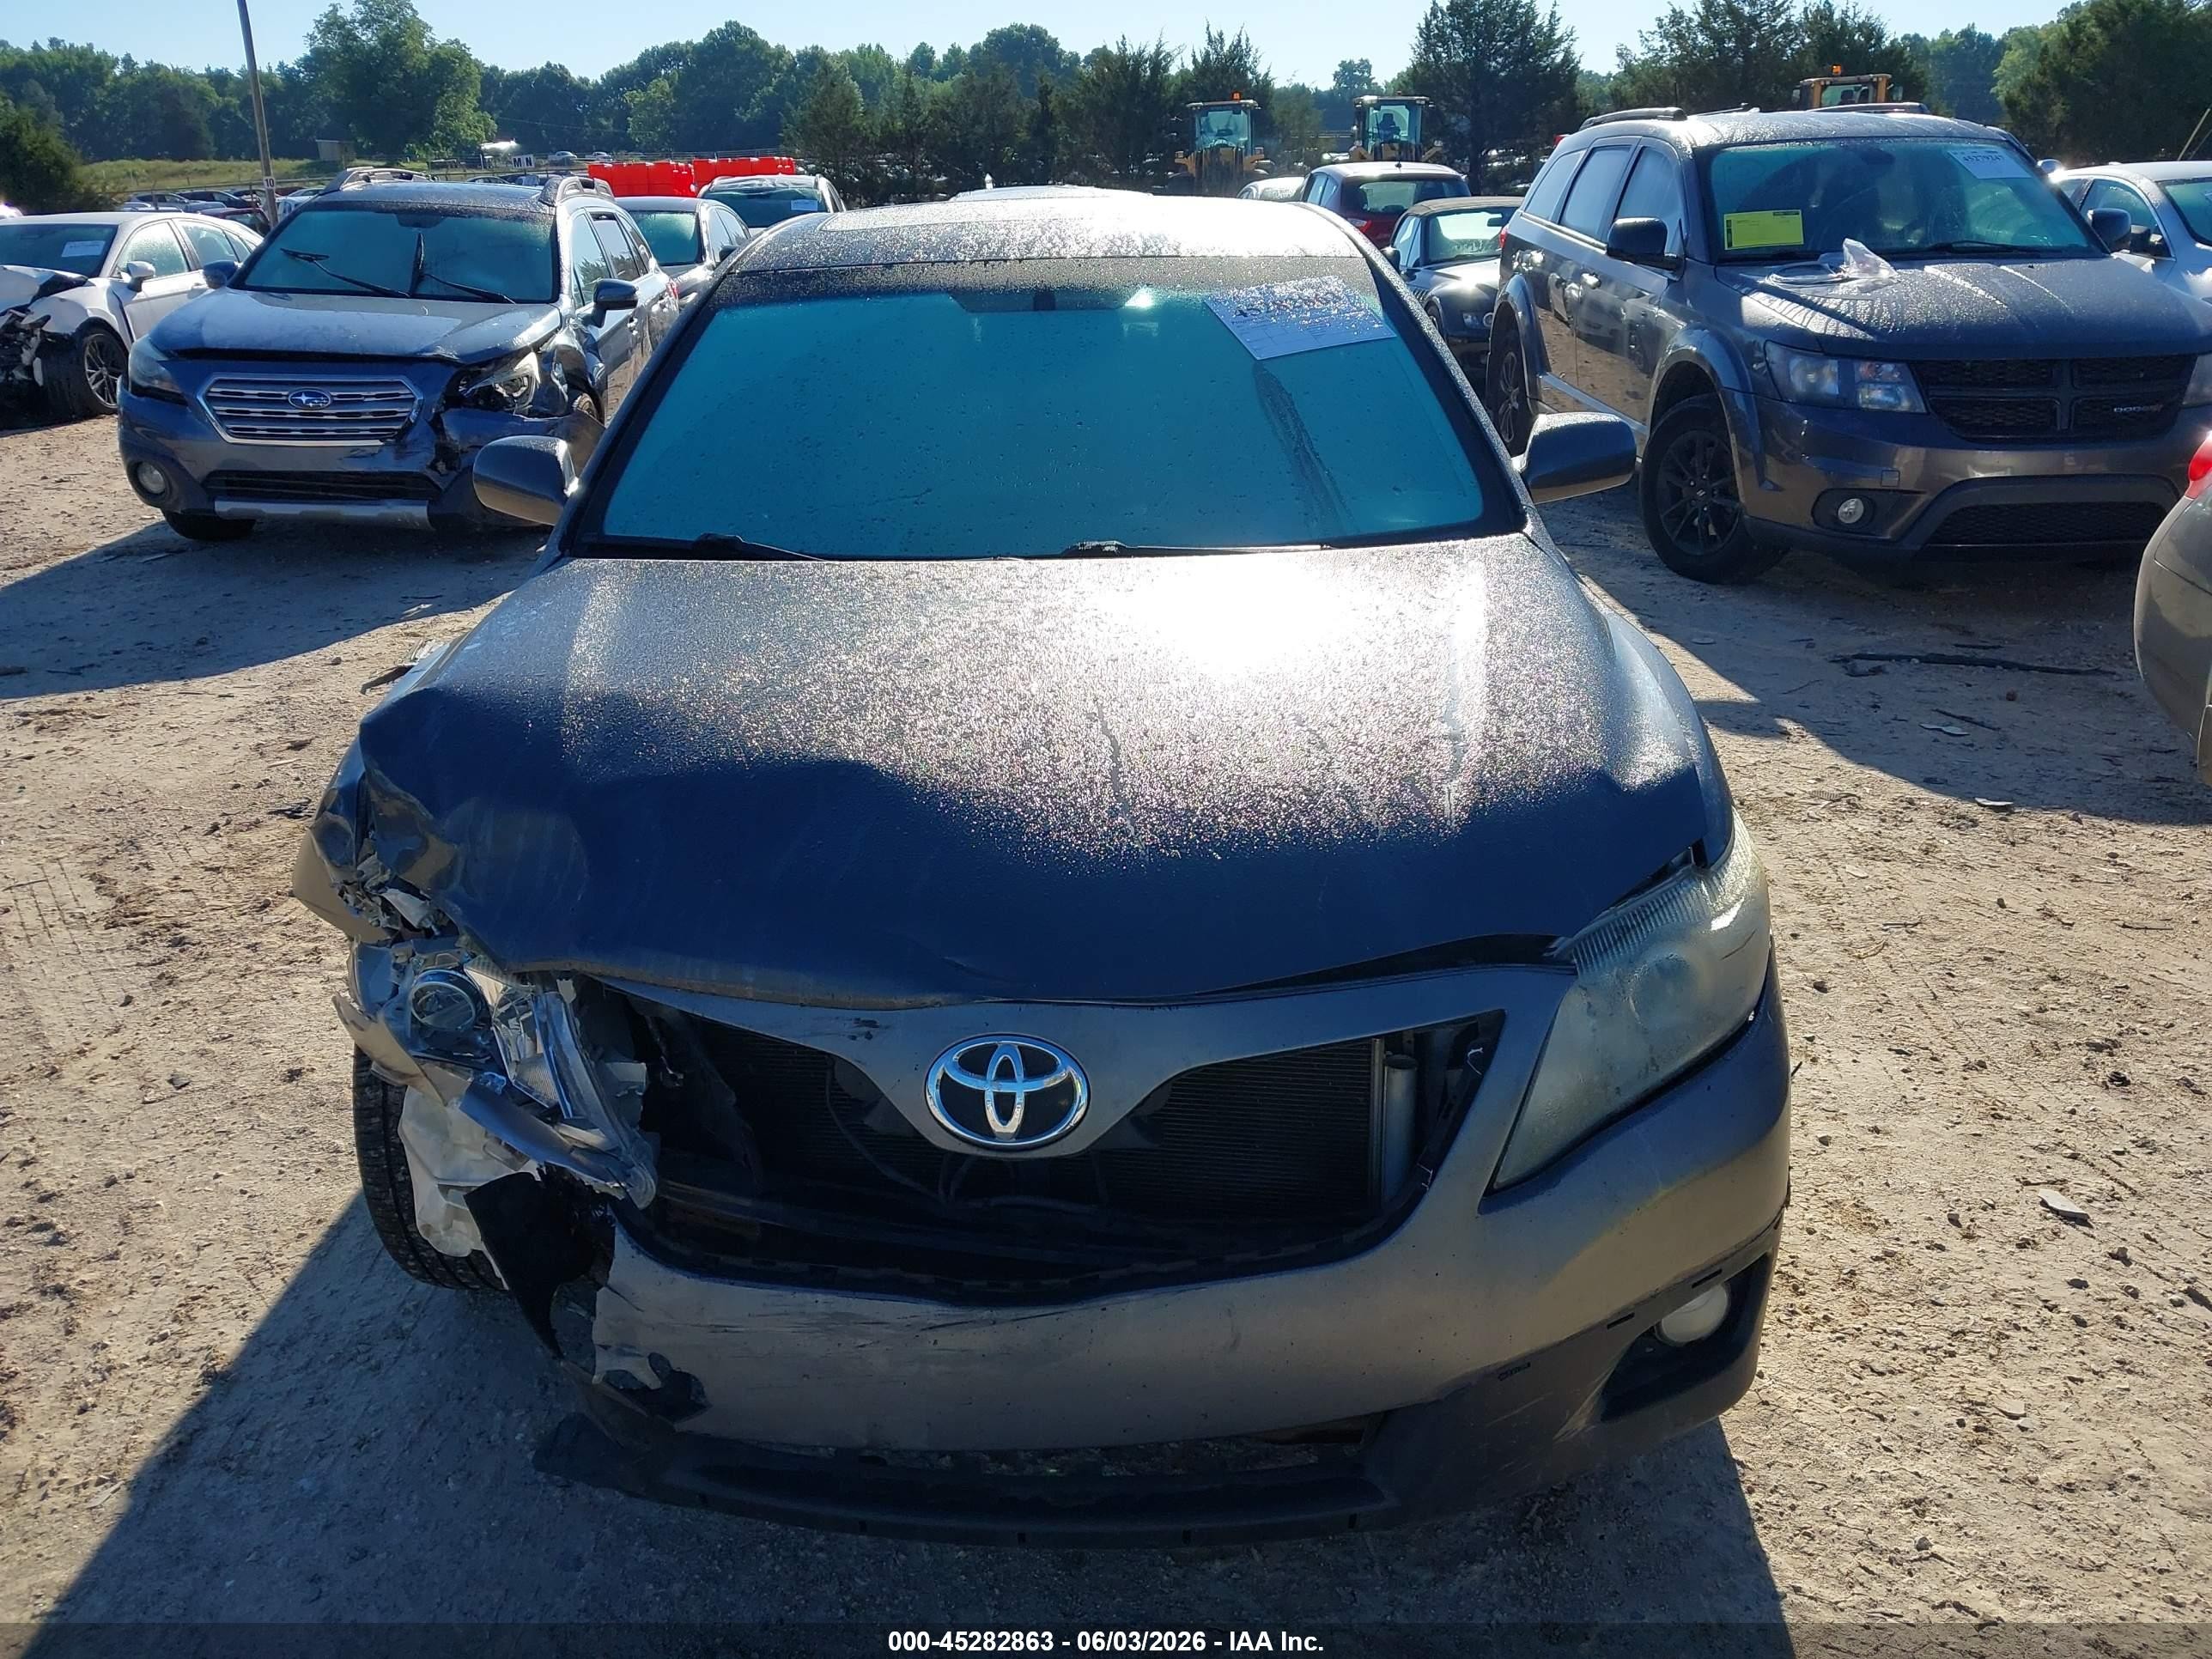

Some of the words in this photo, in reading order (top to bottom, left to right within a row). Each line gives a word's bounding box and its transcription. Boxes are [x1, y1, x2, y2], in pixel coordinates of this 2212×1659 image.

[513, 157, 522, 167] M
[525, 156, 532, 167] N
[264, 178, 274, 187] 10
